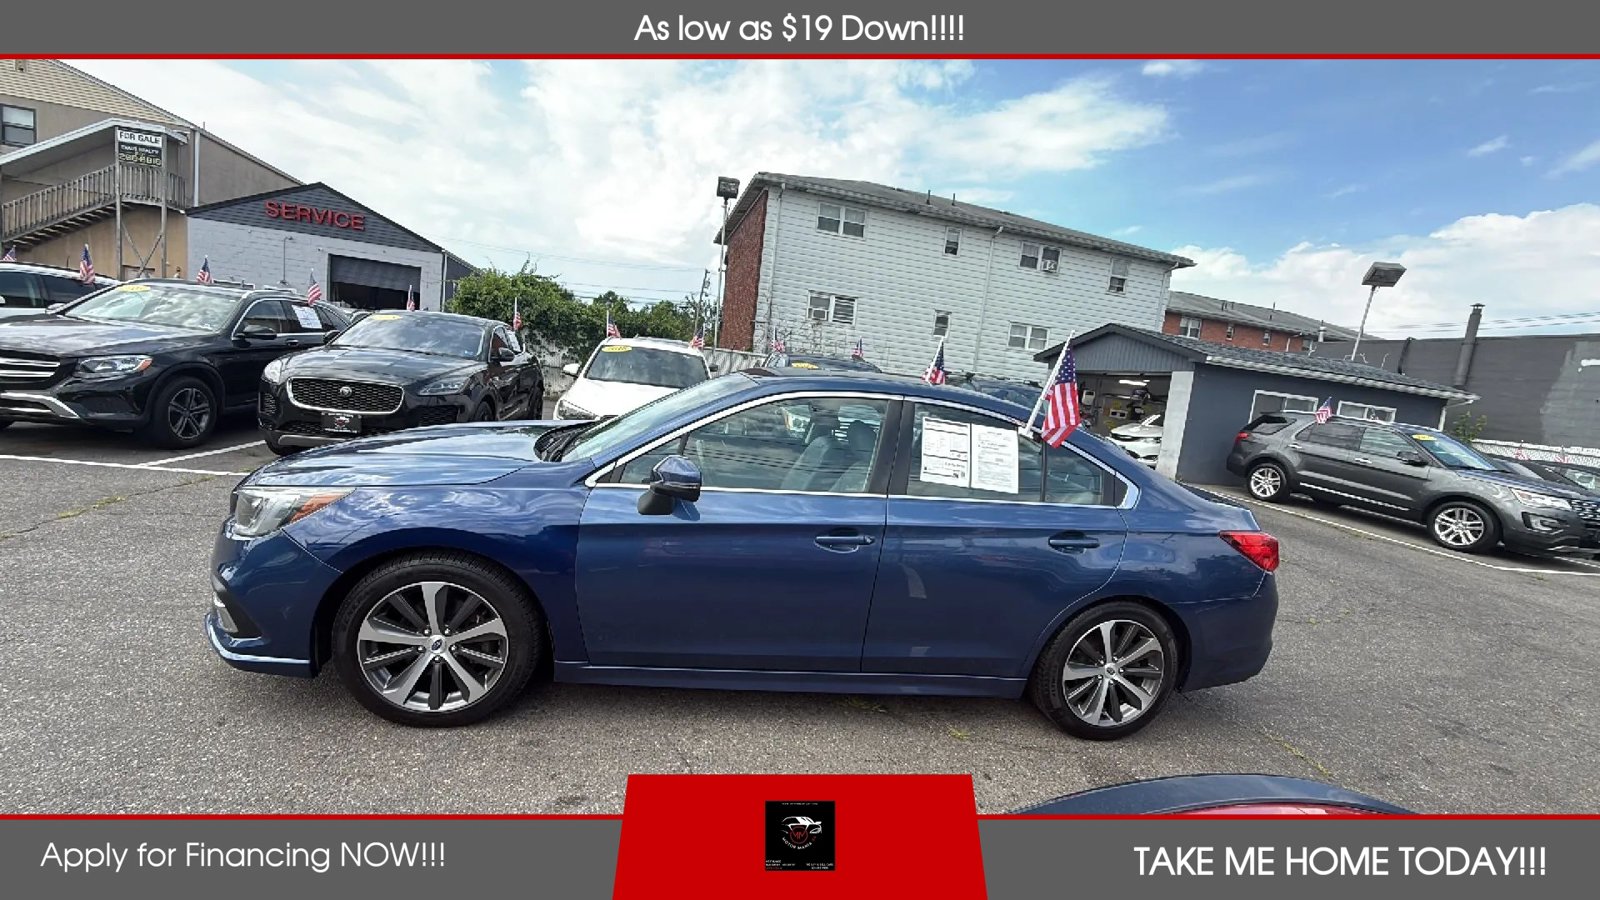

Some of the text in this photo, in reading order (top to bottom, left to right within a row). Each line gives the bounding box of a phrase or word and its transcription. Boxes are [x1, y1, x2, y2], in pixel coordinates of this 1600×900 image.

[120, 131, 160, 143] FOR SALE
[264, 200, 366, 231] SERVICE
